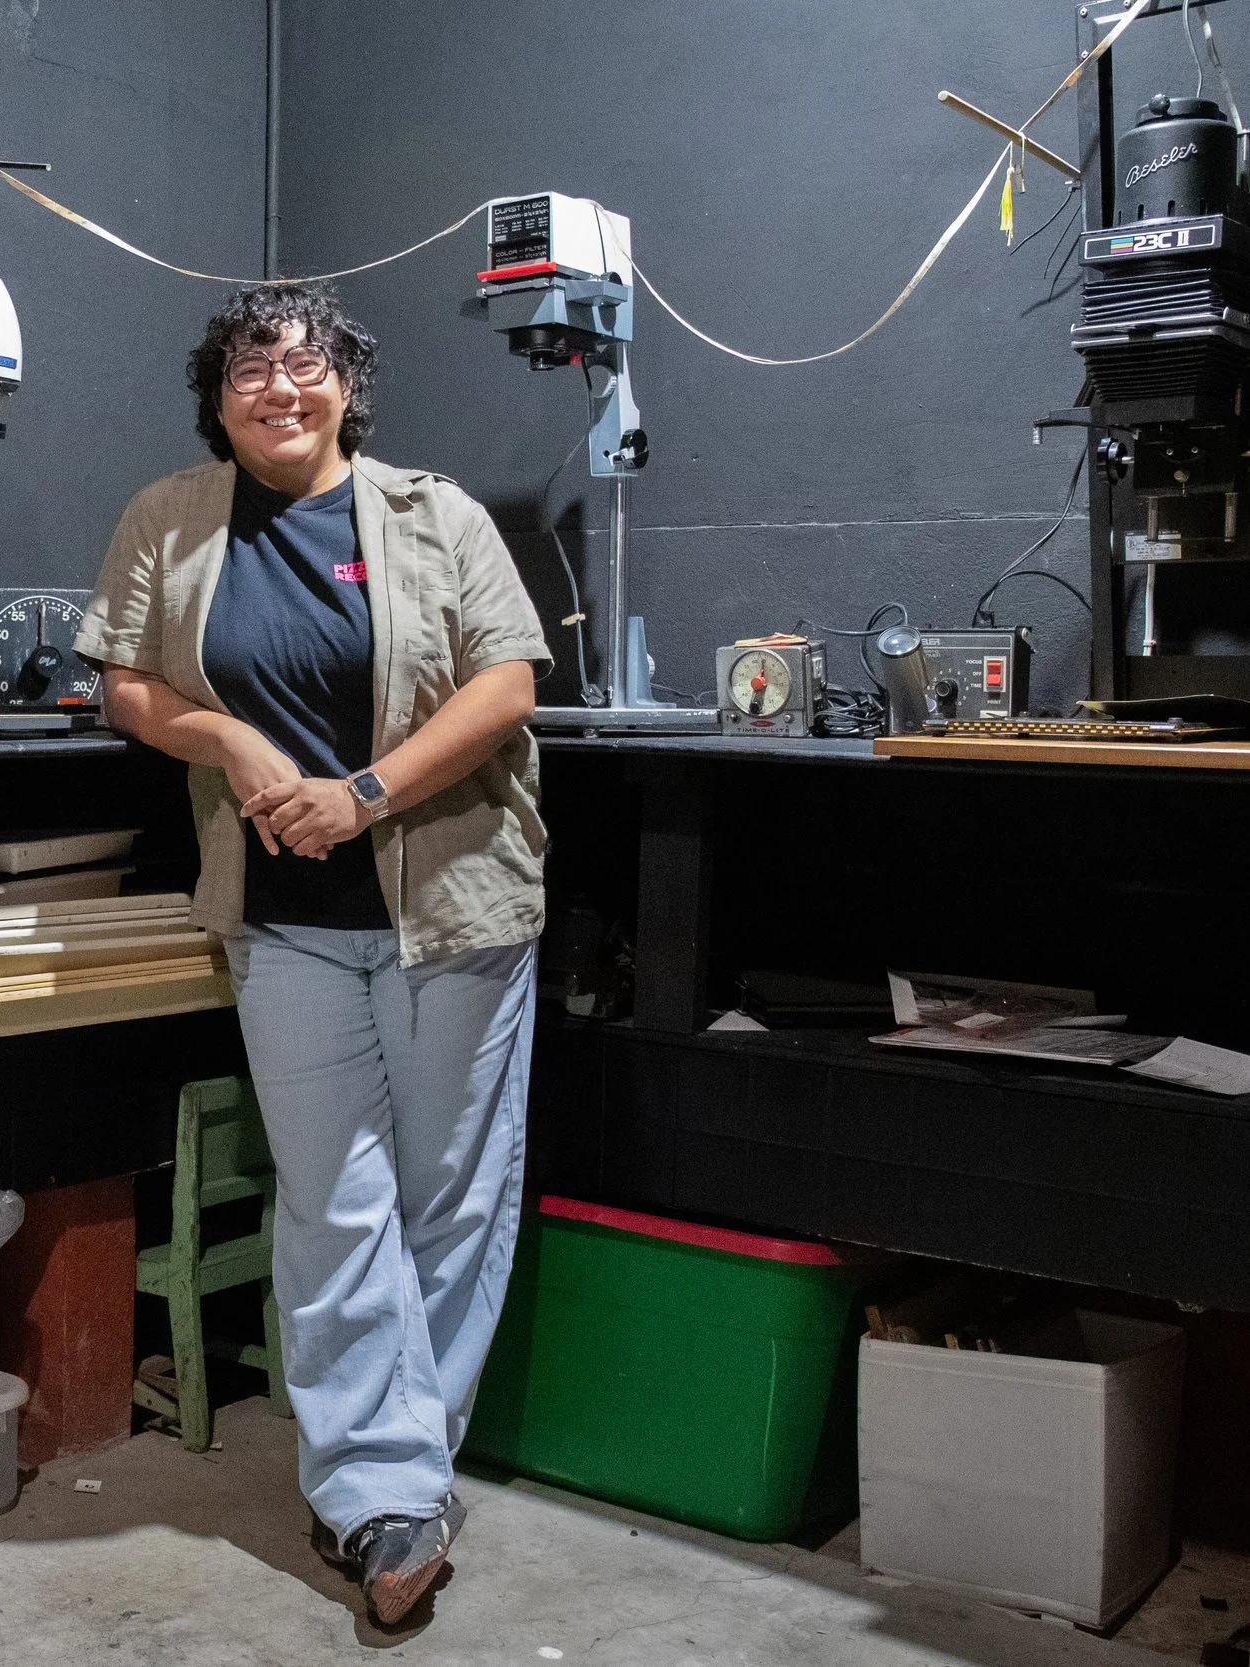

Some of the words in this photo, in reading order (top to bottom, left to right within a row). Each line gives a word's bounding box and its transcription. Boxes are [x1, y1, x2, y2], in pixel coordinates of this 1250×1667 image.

[495, 205, 521, 215] DURST
[1133, 232, 1172, 252] 23C
[11, 611, 26, 621] 55
[62, 611, 70, 621] 5
[73, 681, 87, 692] 20
